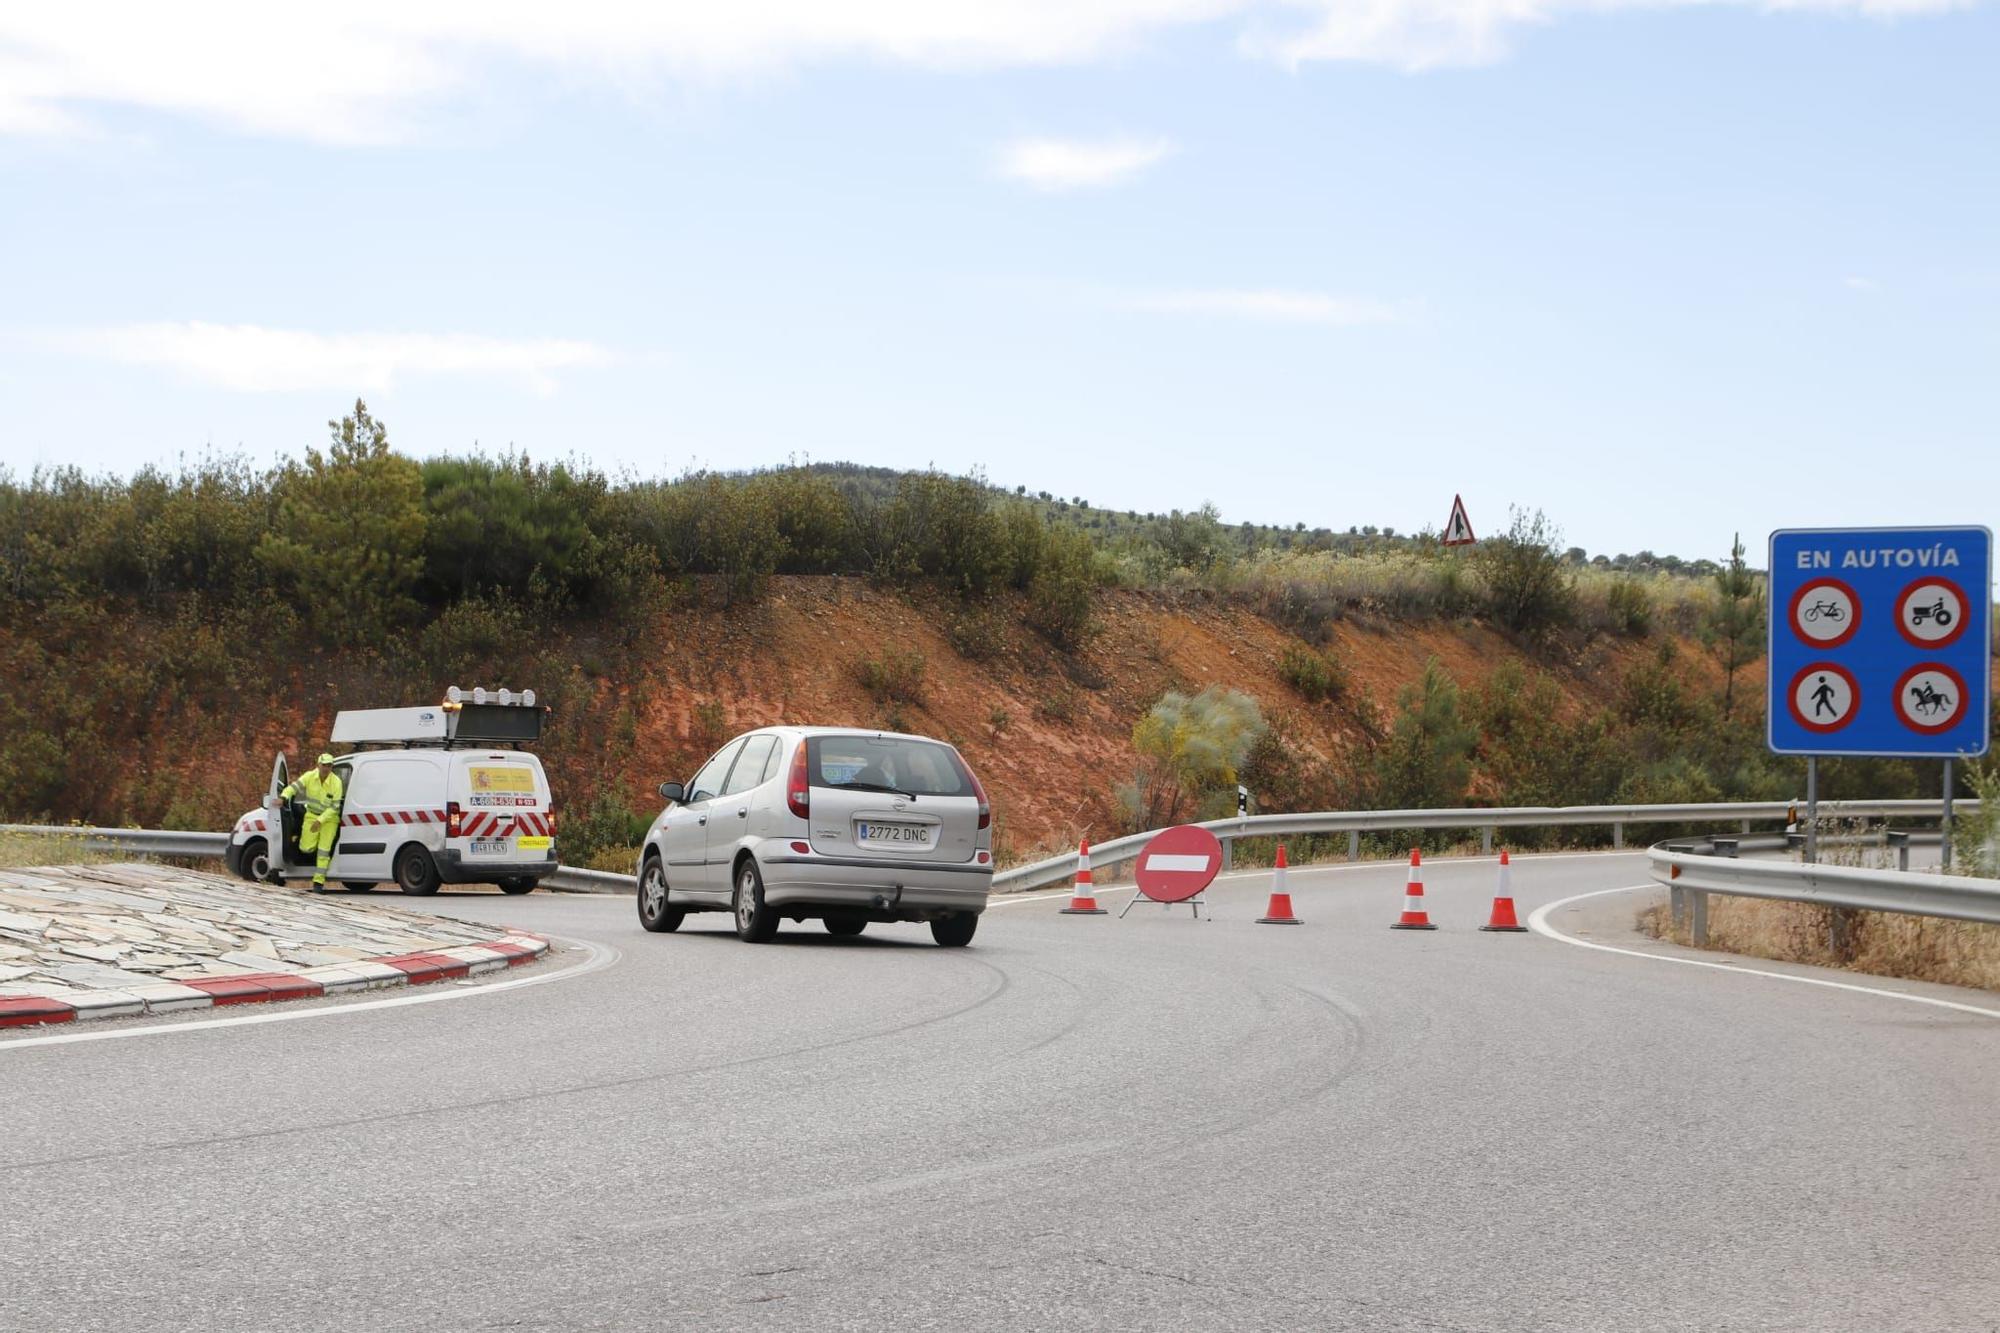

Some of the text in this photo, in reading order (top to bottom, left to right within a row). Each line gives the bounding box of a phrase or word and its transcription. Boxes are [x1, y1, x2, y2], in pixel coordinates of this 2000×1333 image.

[1797, 543, 1960, 568] EN AUTOVÍA
[869, 826, 927, 841] 2772 DNC
